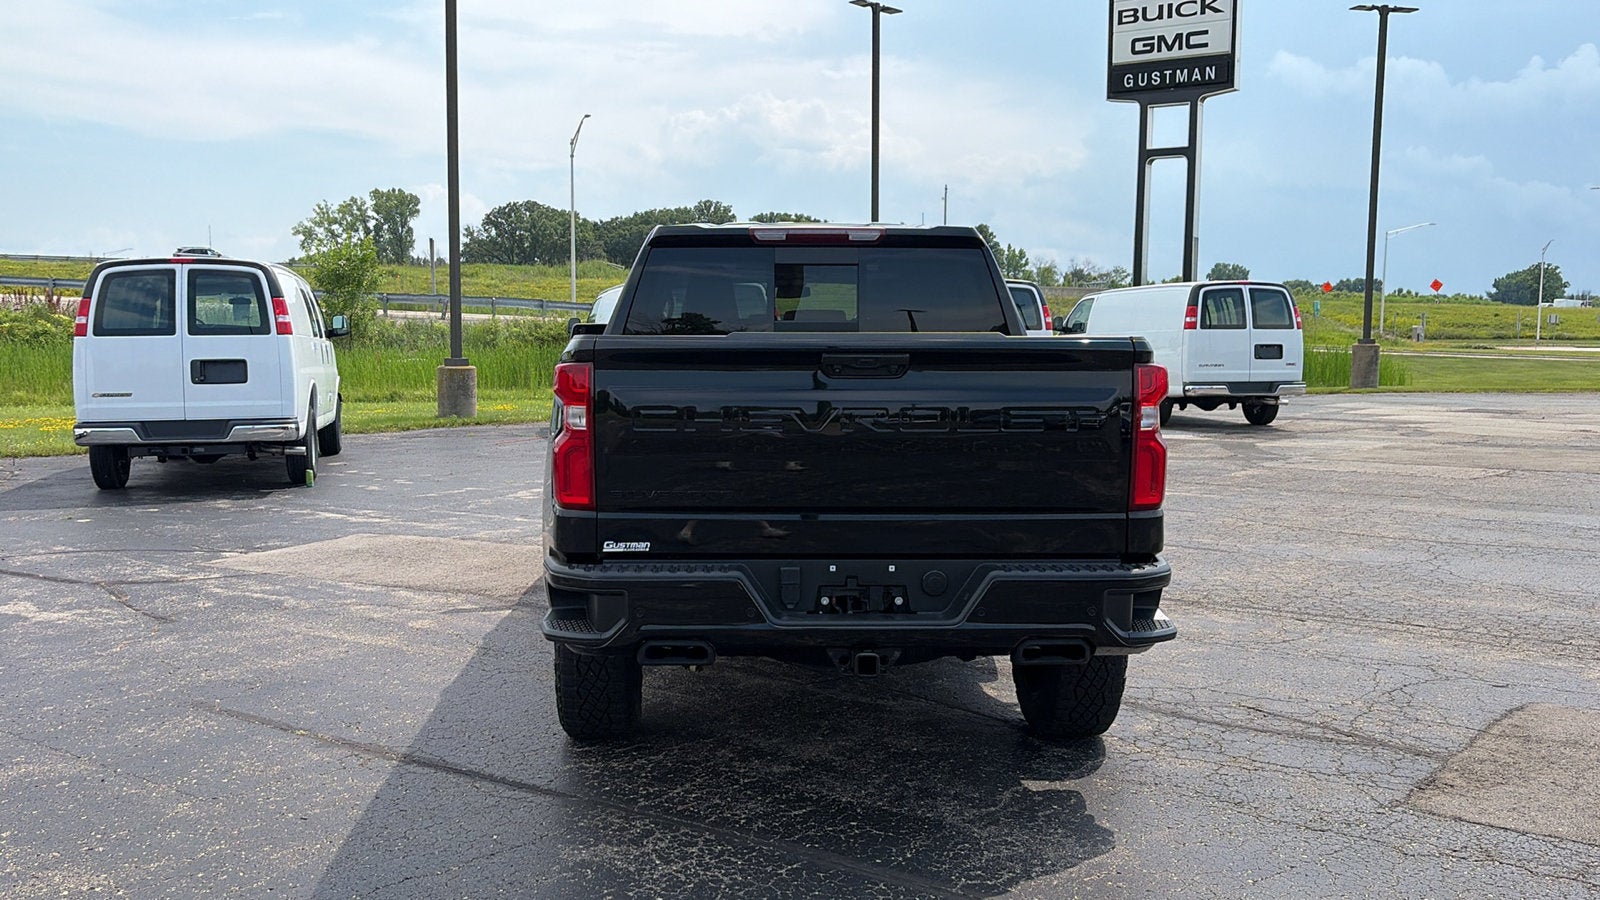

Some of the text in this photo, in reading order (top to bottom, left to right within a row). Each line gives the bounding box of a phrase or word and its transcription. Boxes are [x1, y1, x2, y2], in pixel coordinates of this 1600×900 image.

[1117, 0, 1225, 26] BUICK
[1131, 29, 1209, 55] GMC
[1124, 65, 1216, 87] GUSTMAN
